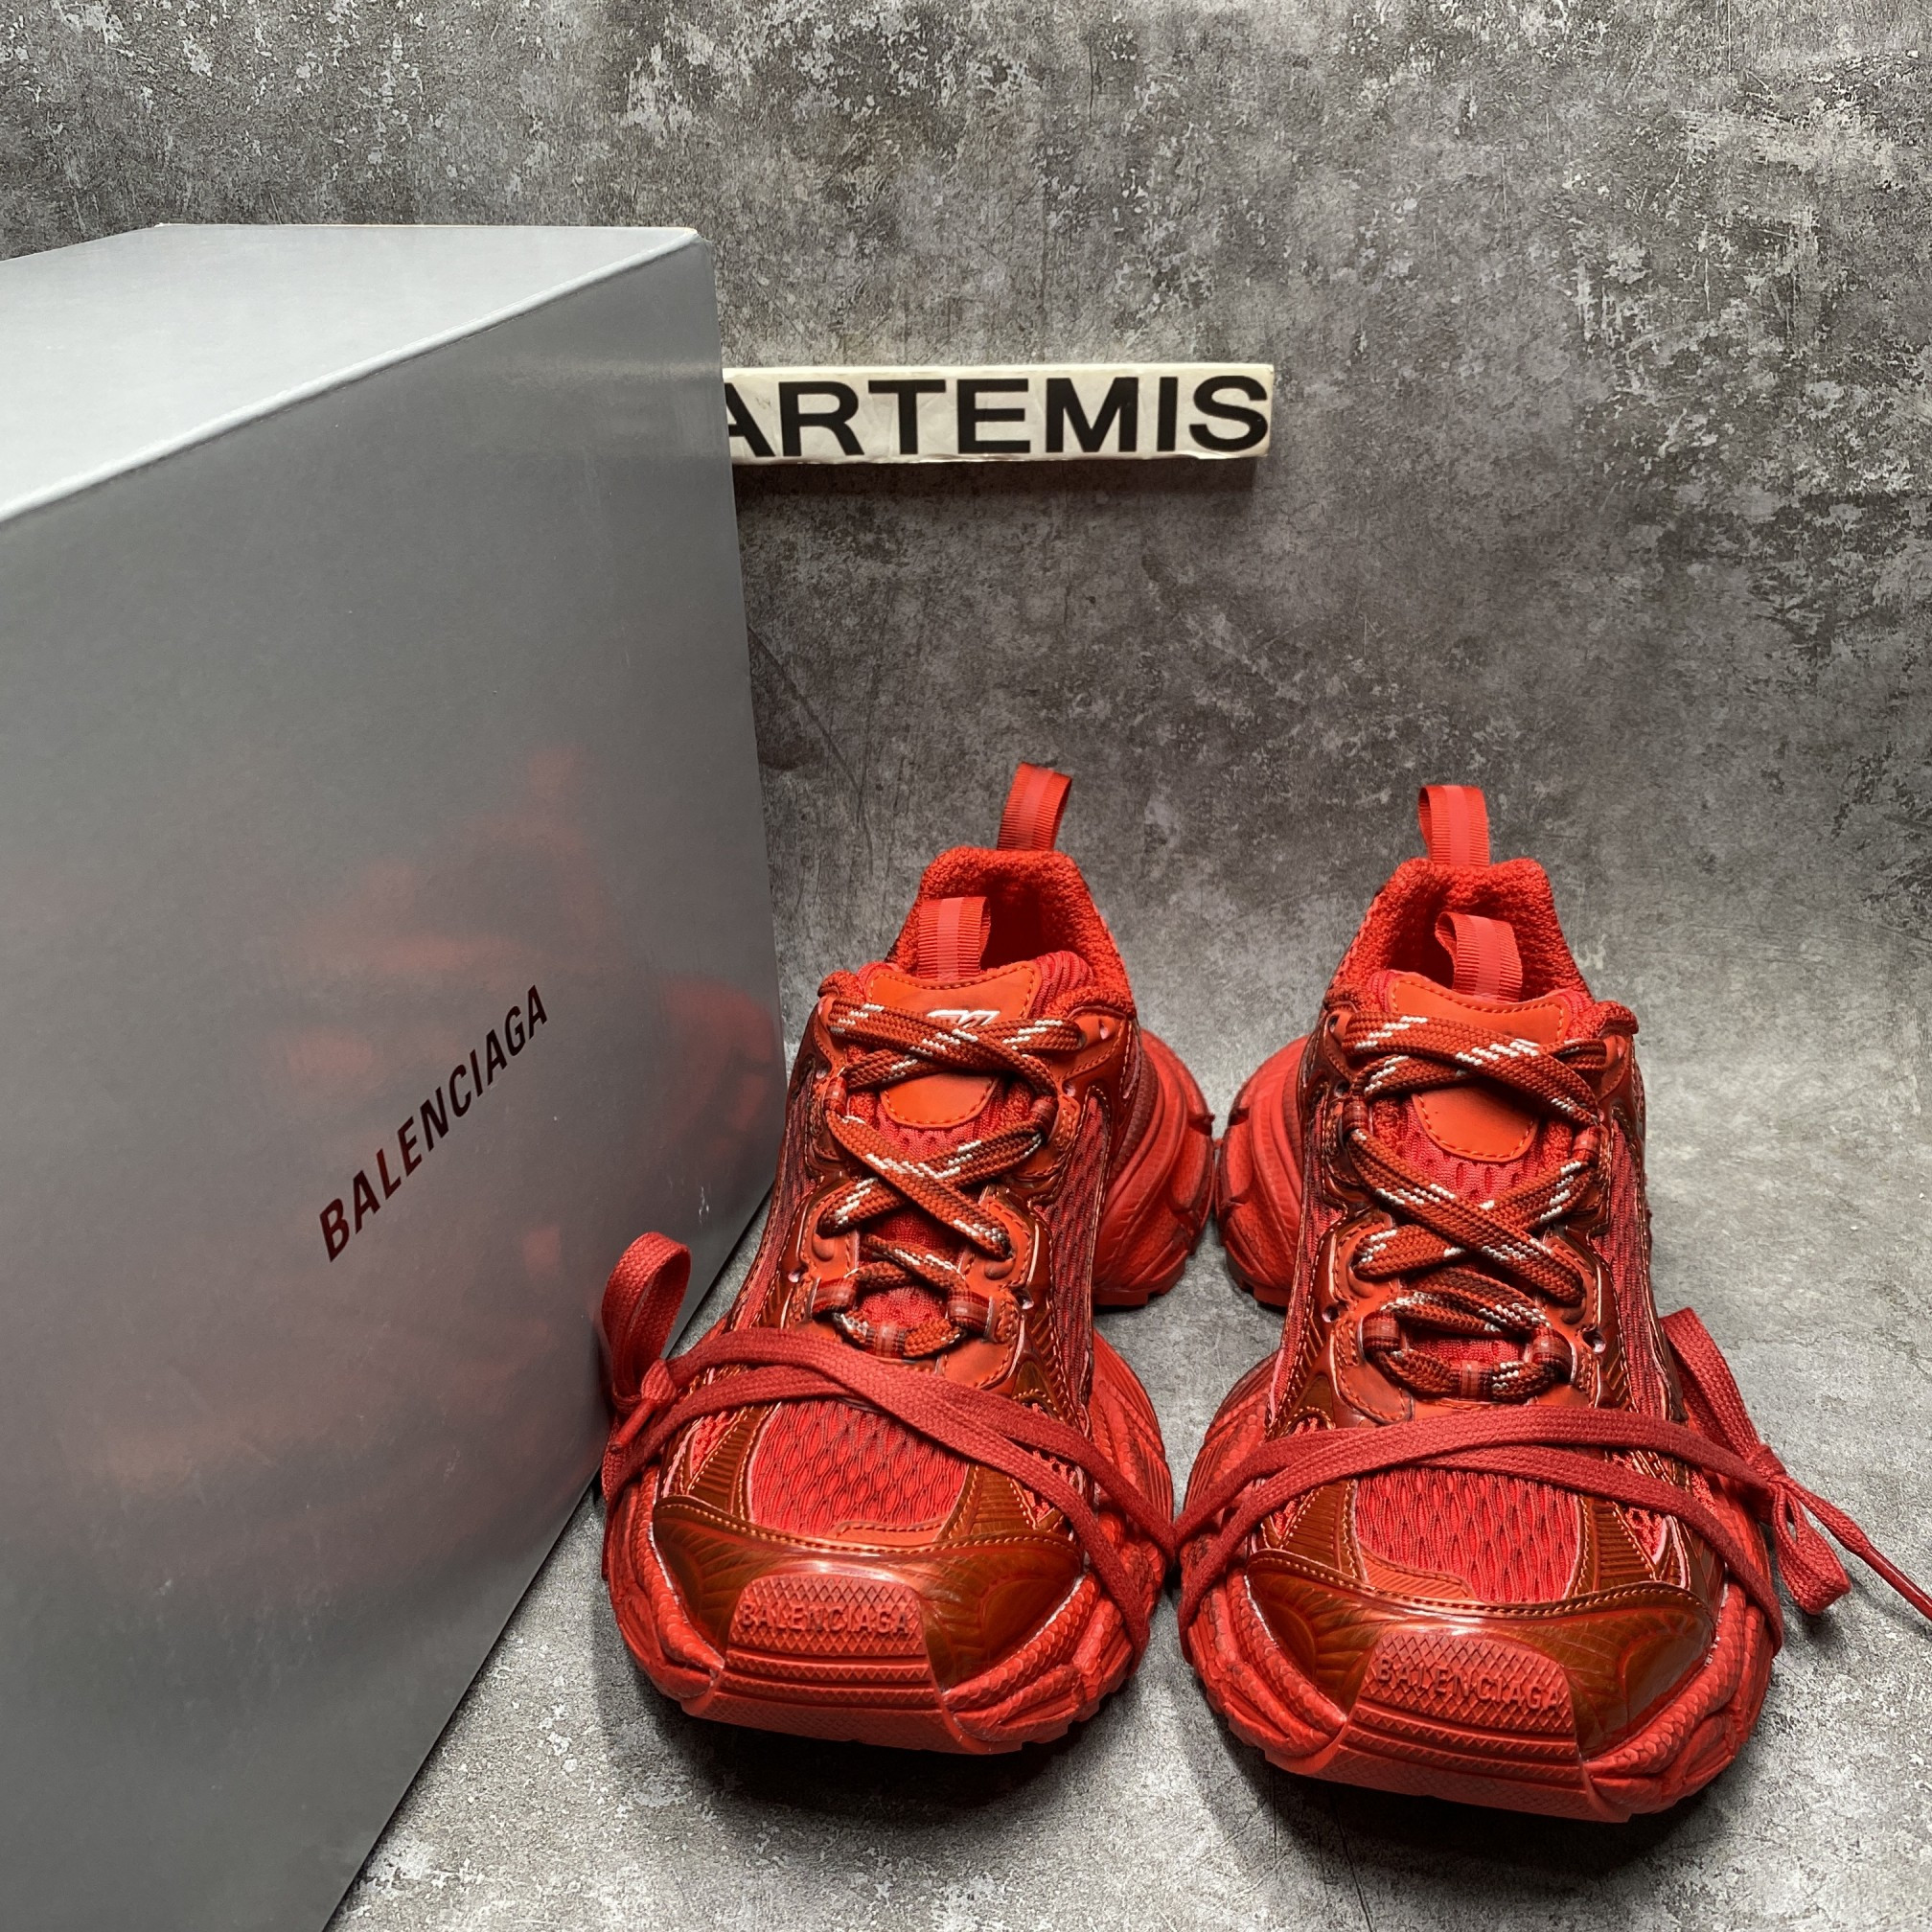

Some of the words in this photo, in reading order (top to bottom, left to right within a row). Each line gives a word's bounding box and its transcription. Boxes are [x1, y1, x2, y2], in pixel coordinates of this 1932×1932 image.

[724, 375, 1269, 457] ARTEMIS
[319, 984, 548, 1263] BALENCIAGA
[741, 1598, 910, 1638] BALENCIAGA
[1376, 1652, 1564, 1713] BALENCIAGA
